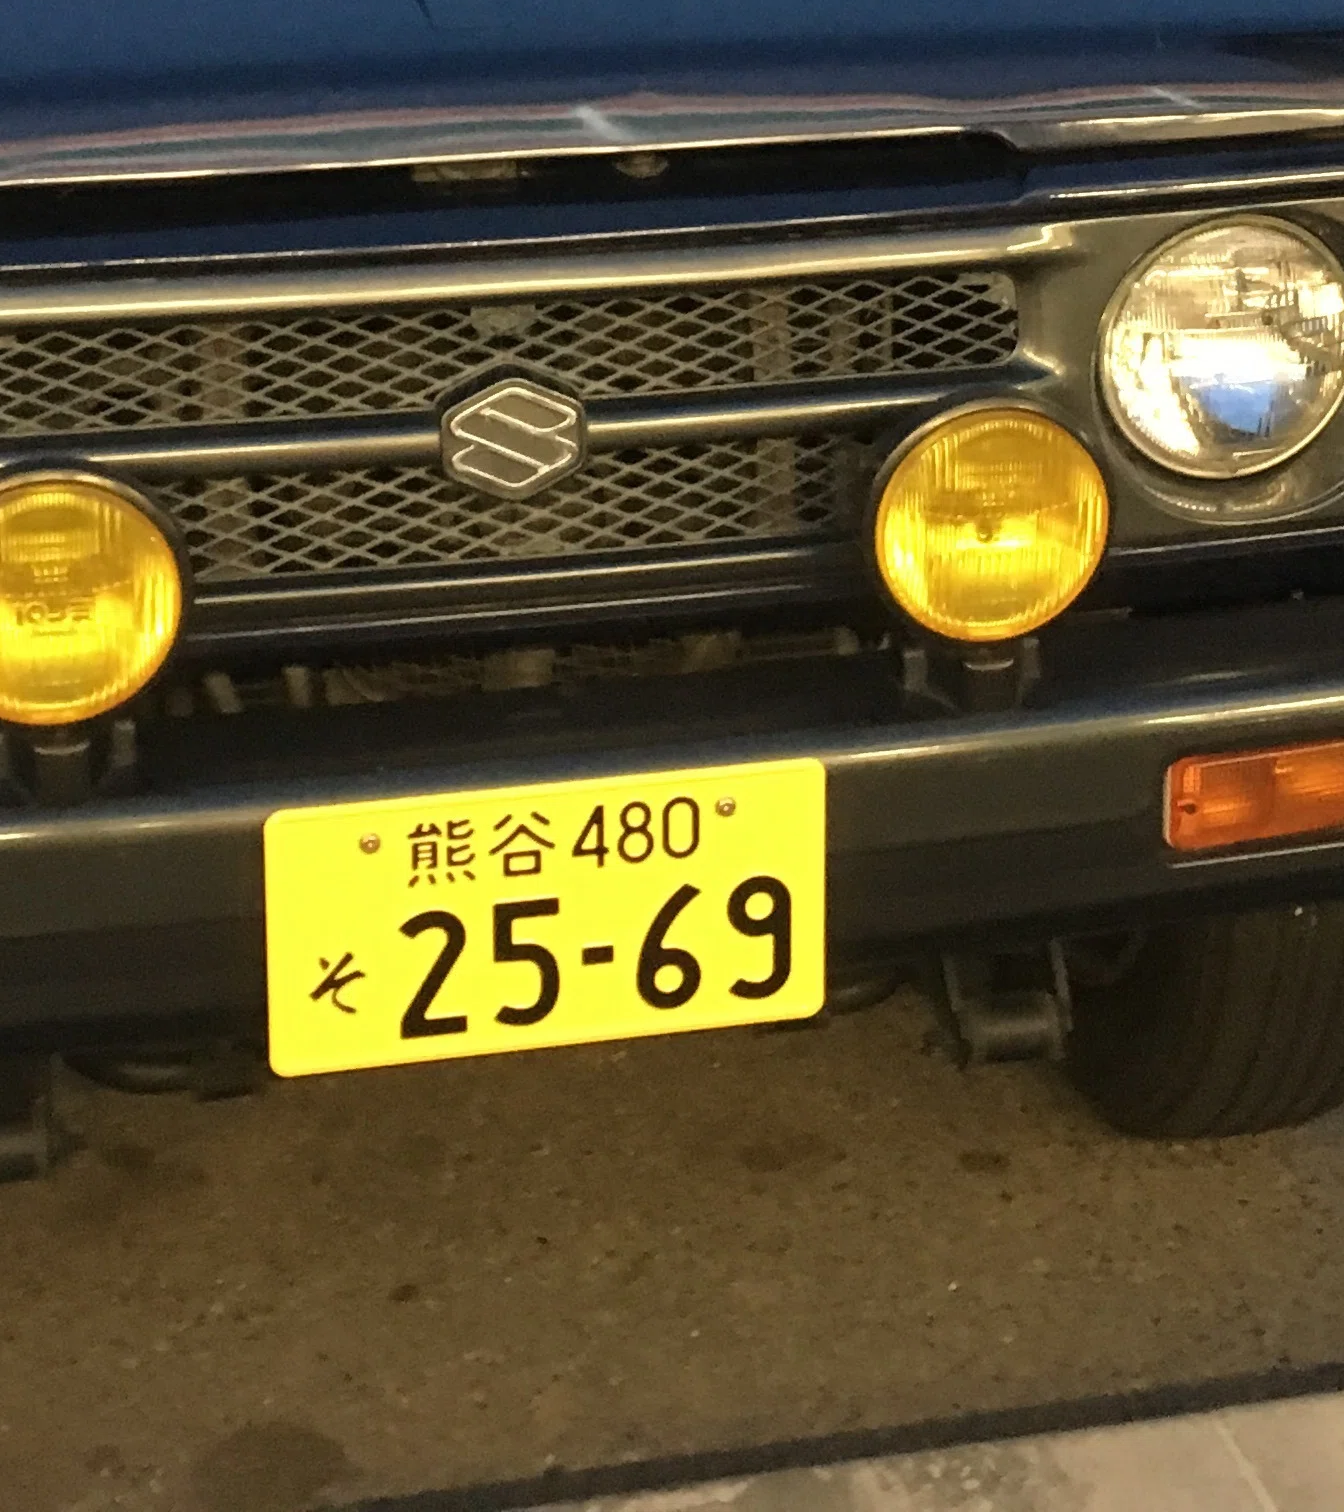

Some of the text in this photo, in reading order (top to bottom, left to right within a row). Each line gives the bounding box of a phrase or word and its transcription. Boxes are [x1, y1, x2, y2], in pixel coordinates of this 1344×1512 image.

[408, 797, 699, 886] 熊谷 480
[311, 876, 791, 1039] そ 25-69
